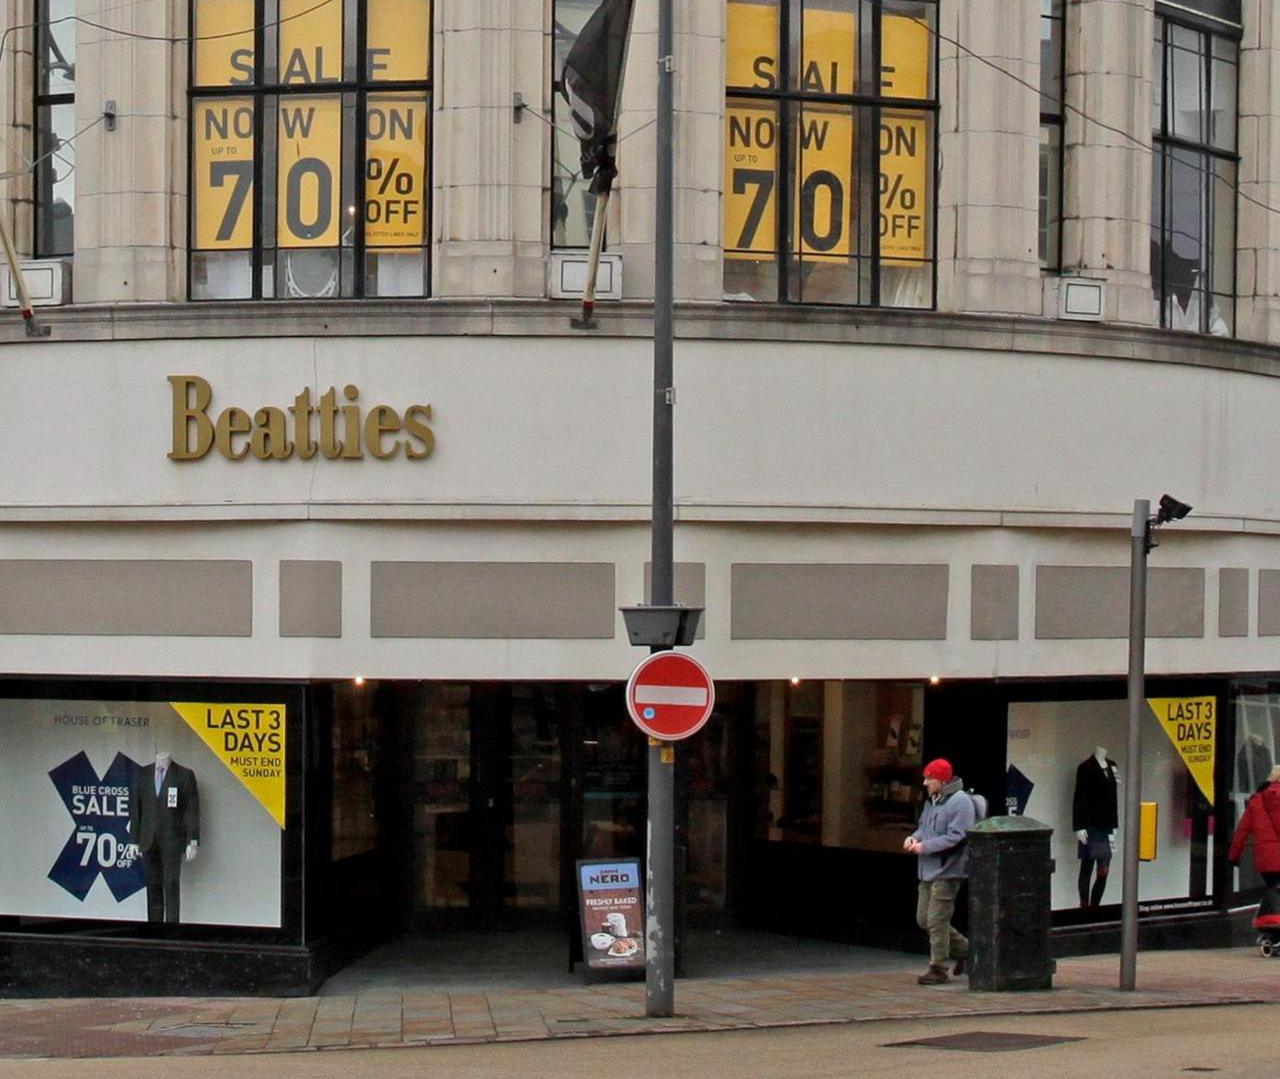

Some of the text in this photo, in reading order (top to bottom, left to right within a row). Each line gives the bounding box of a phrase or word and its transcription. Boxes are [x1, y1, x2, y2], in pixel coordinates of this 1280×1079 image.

[230, 46, 391, 86] SALE
[211, 146, 237, 156] UP TO
[366, 200, 419, 225] OFF
[167, 375, 436, 460] Beatties
[1167, 702, 1213, 721] LAST 3
[54, 715, 150, 727] HOUSE OF FRASER
[207, 708, 280, 730] LAST 3
[1177, 722, 1212, 741] DAYS
[224, 731, 281, 753] DAYS
[1180, 744, 1212, 754] MUST END
[230, 757, 281, 767] MUST END
[1188, 754, 1211, 763] SUNDAY
[243, 768, 281, 778] SUNDAY
[72, 785, 129, 796] BLUE CROSS
[72, 796, 129, 816] SALE
[117, 860, 132, 868] OFF
[589, 873, 630, 884] NERO
[586, 897, 637, 906] FRESHLY BAKED
